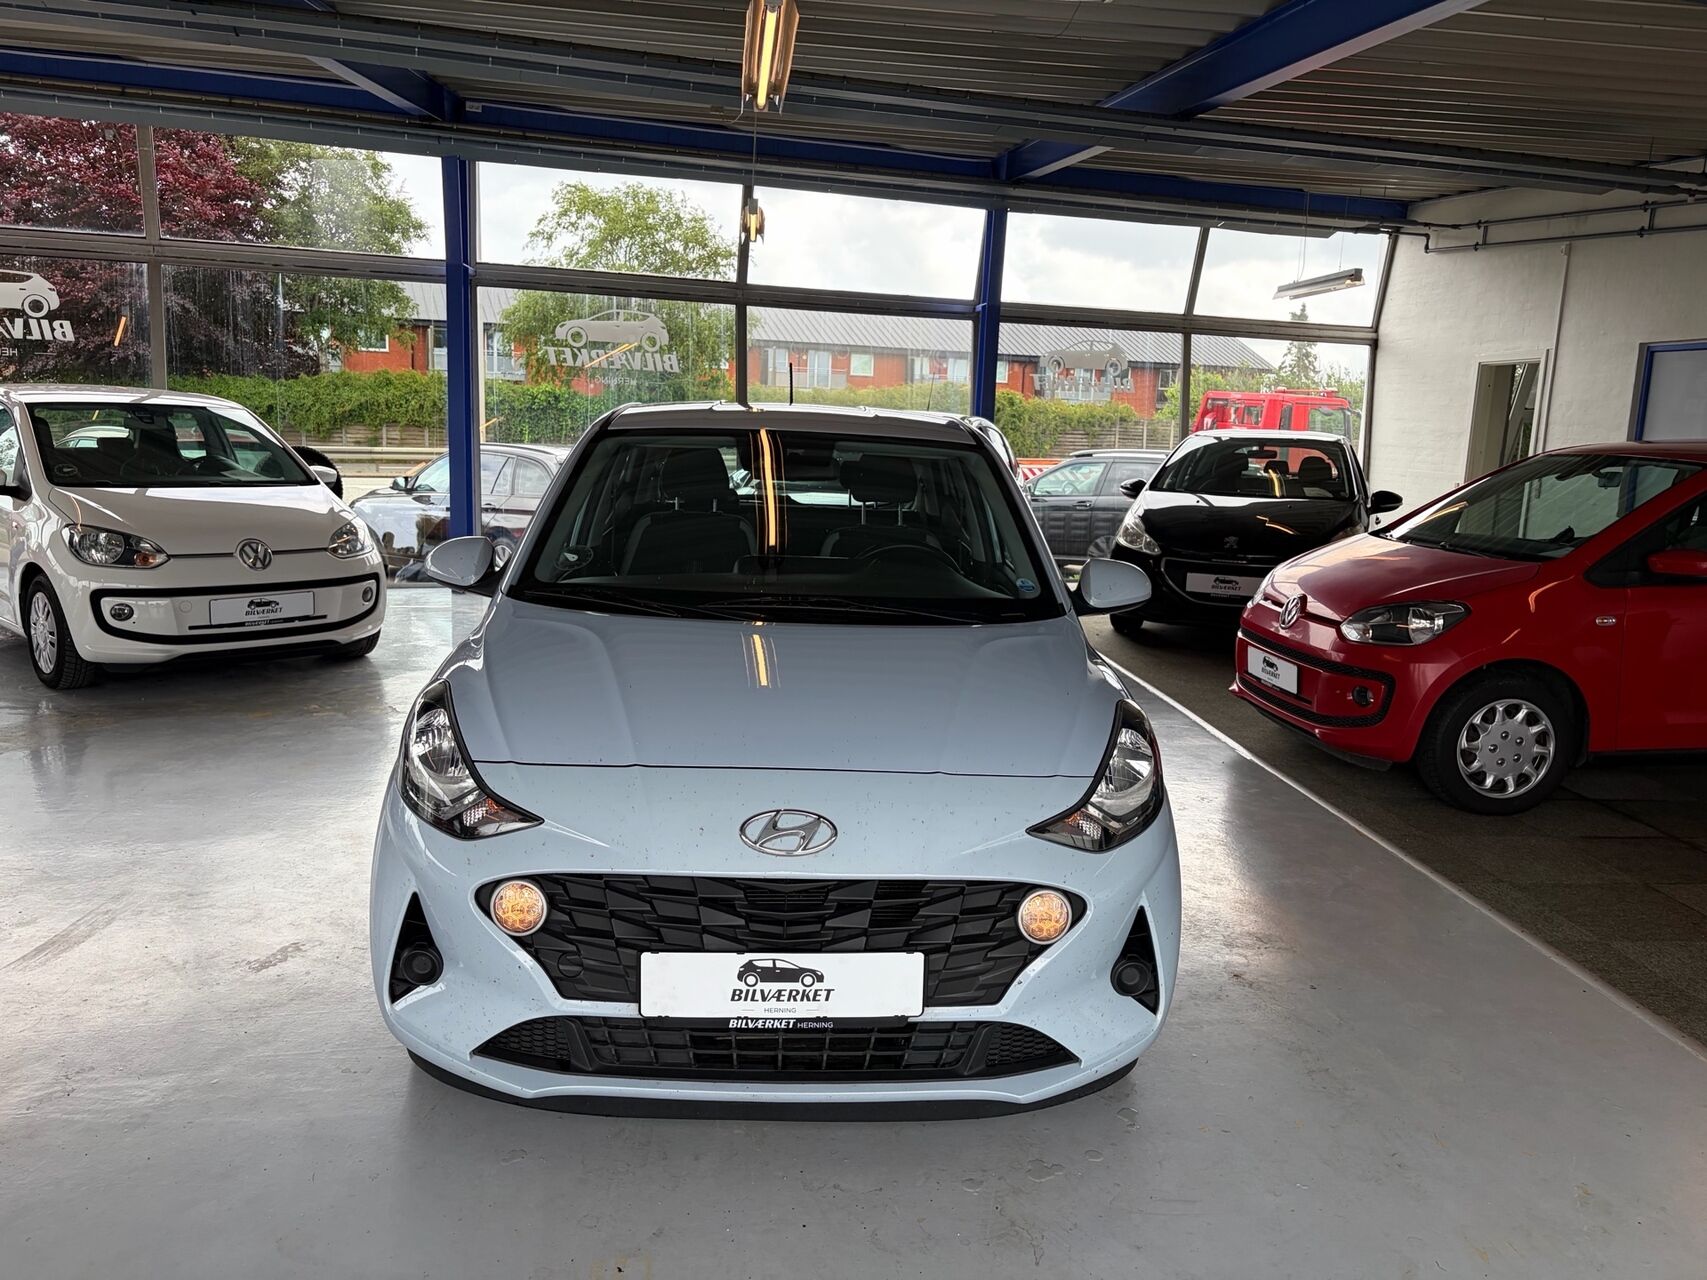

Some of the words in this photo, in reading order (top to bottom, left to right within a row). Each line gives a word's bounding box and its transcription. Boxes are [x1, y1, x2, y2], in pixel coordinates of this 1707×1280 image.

[730, 988, 835, 1002] BILVÆRKET
[728, 1018, 797, 1029] BILVÆRKET
[797, 1021, 834, 1029] HERNING
